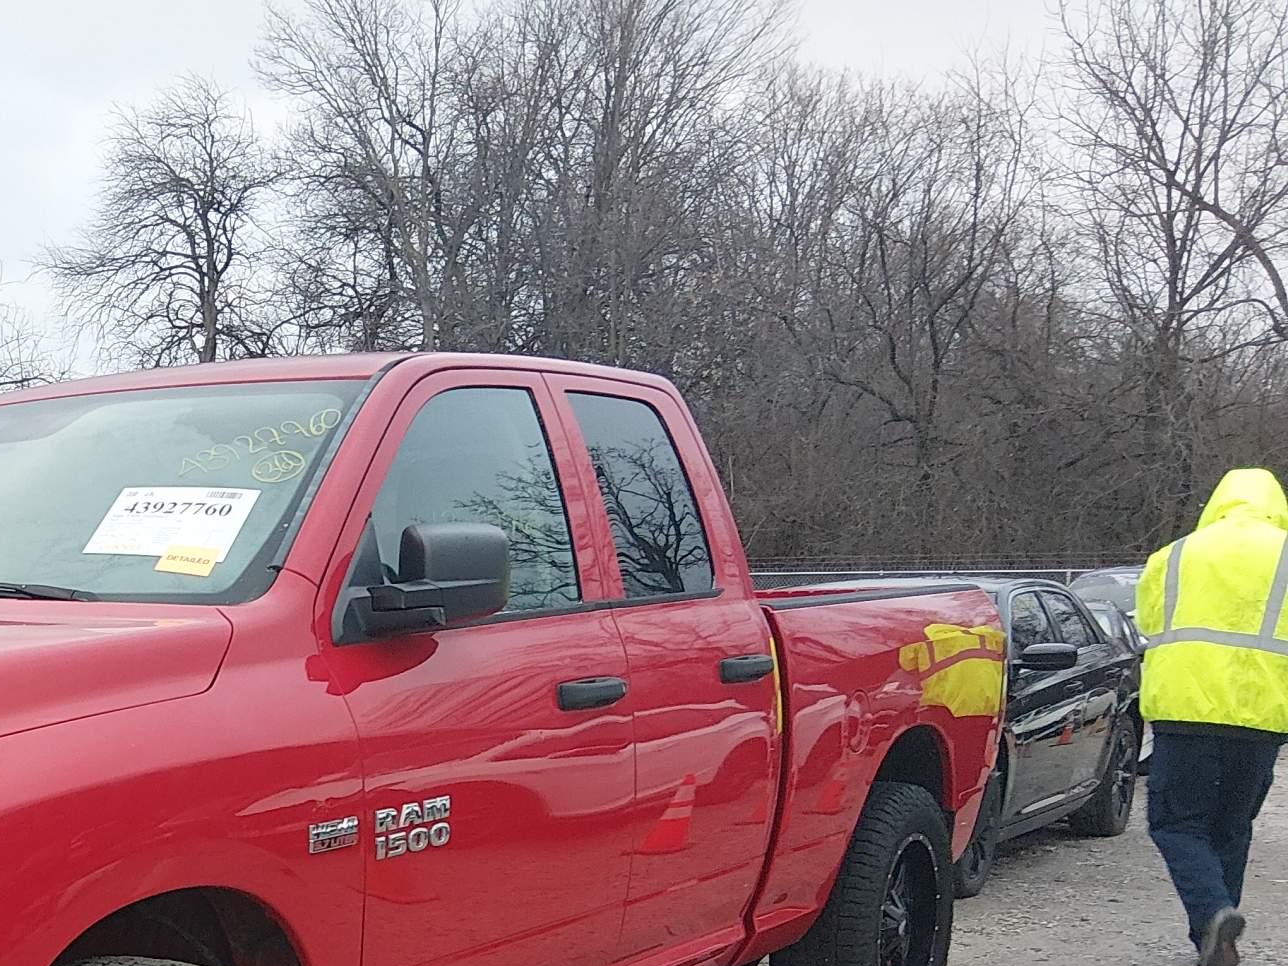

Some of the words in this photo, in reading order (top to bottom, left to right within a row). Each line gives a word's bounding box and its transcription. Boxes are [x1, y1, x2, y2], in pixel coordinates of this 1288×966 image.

[178, 408, 342, 478] 43927760
[124, 501, 233, 517] 43927760
[374, 795, 451, 833] RAM
[374, 822, 451, 861] 1500
